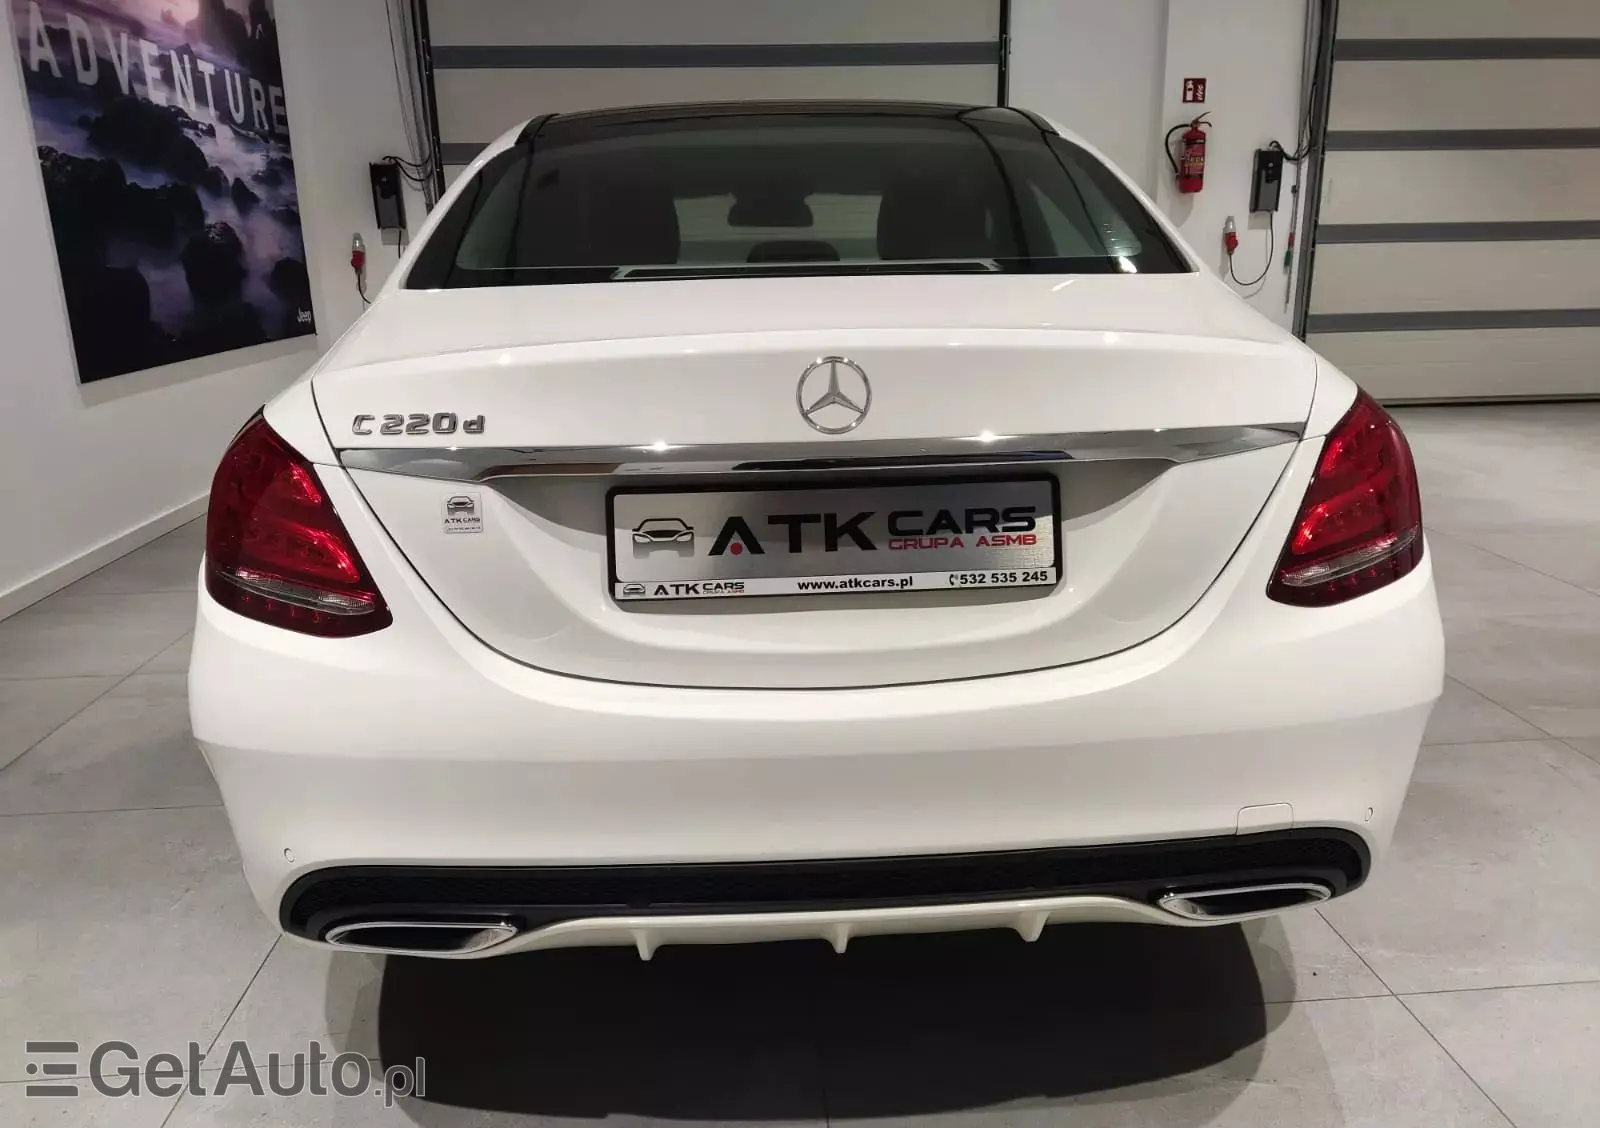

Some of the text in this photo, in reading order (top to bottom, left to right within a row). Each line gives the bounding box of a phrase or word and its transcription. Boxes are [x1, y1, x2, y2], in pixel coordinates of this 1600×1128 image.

[28, 1, 291, 137] ADVENTURE
[296, 307, 312, 325] Jeep
[708, 506, 1036, 556] ATK CARS
[888, 534, 1037, 550] GRUPA ASMB
[797, 576, 913, 590] www.atkcars.pl
[959, 571, 1048, 585] 532 535 245
[653, 581, 745, 596] ATK CARS
